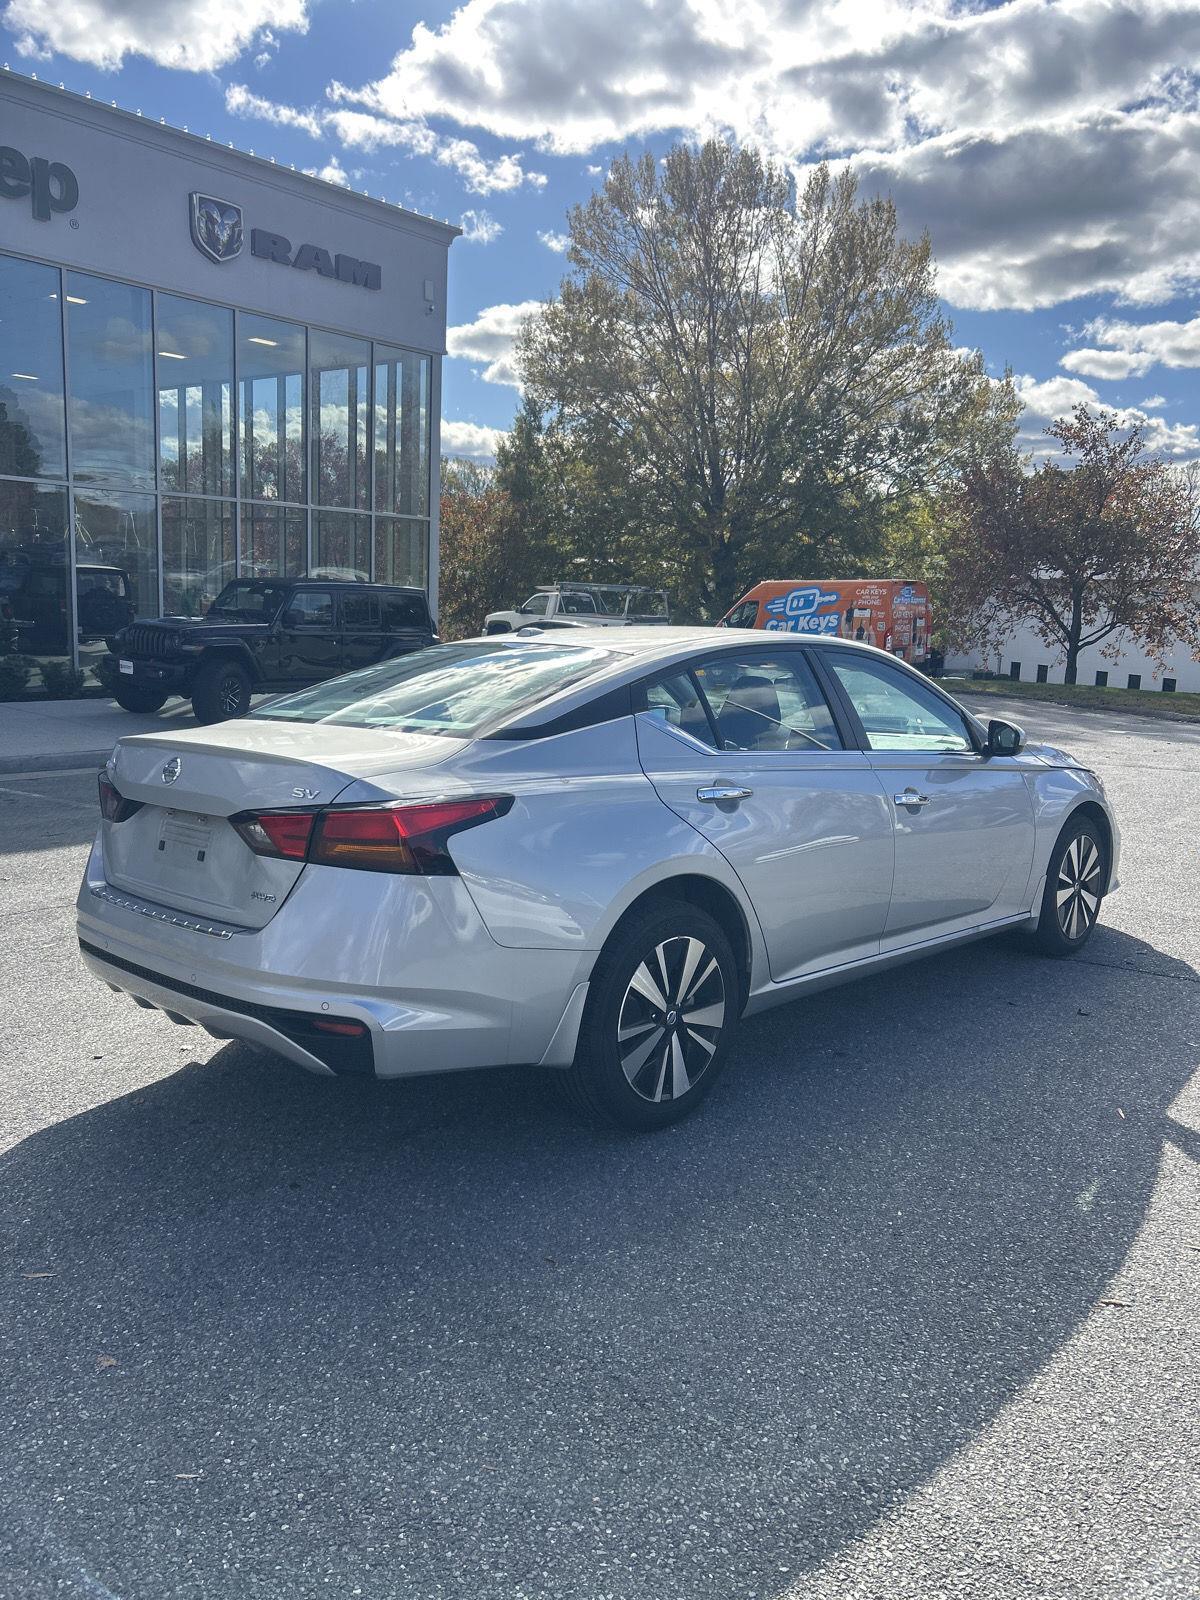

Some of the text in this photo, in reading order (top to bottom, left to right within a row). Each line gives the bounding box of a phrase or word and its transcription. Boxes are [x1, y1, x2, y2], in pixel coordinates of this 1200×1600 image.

[251, 228, 381, 290] RAM
[766, 614, 839, 632] Car Keys
[291, 787, 320, 799] SV
